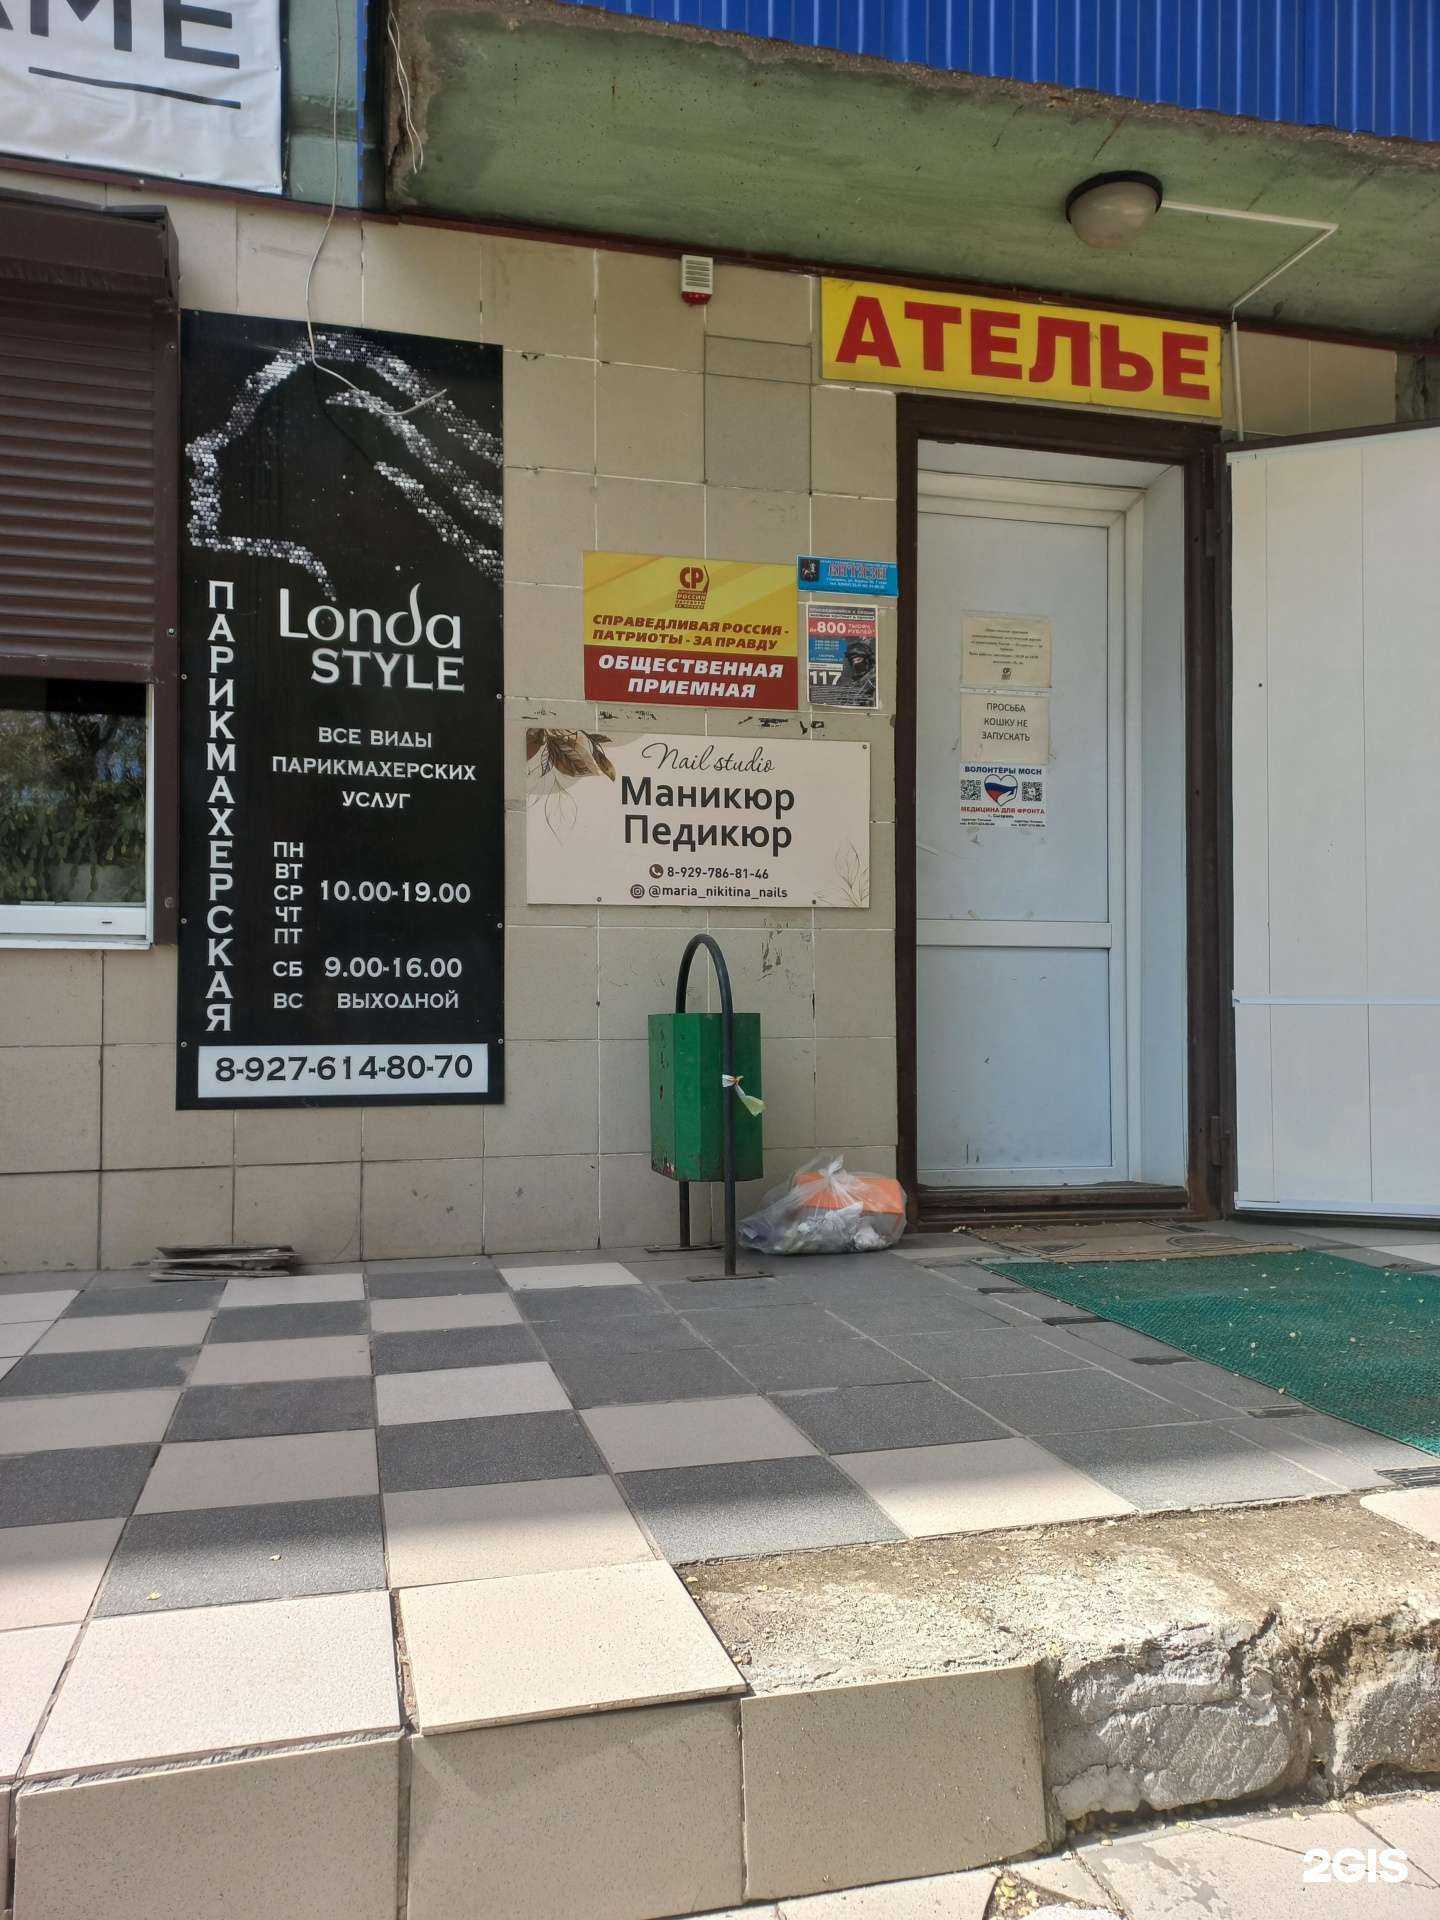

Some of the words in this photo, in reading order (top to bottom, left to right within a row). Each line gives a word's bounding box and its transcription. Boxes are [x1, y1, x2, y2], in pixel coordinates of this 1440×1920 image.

[836, 295, 1210, 400] АТЕЛЬЕ
[679, 566, 704, 589] СР
[279, 582, 461, 650] Londa
[592, 614, 720, 633] СПРАВЕДЛИВАЯ
[721, 623, 782, 636] РОССИЯ
[817, 621, 846, 635] 800
[592, 629, 683, 645] ПАТРИОТЫ
[692, 635, 712, 646] ЗА
[715, 636, 778, 651] ПРАВДУ
[311, 648, 465, 693] STYLE
[598, 654, 784, 679] ОБЩЕСТВЕННАЯ
[627, 678, 757, 699] ПРИЕМНАЯ
[809, 671, 842, 686] 117
[986, 702, 1026, 713] ПРОСЬБА
[984, 717, 1016, 727] КОШКУ
[1016, 719, 1028, 728] НЕ
[318, 726, 361, 745] ВСЕ
[370, 730, 432, 748] ВИДЫ
[981, 731, 1030, 742] ЗАПУСКАТЬ
[271, 756, 477, 781] ПАРИКМАХЕРСКИХ
[641, 742, 713, 771] Nail
[712, 746, 775, 774] studio
[205, 579, 237, 1032] ПАРИКМАХЕРСКАЯ
[341, 791, 411, 809] УСЛУГ
[621, 775, 796, 820] Маникюр
[960, 806, 1000, 815] МЕДИЦИНА
[1001, 807, 1016, 815] ДЛЯ
[1017, 808, 1045, 816] ФРОНТА
[624, 814, 793, 857] Педикюр
[273, 841, 304, 858] ПН
[275, 863, 303, 880] ВТ
[666, 866, 769, 881] 8-929-786-81-46
[273, 885, 304, 901] СР
[320, 880, 472, 904] 10.00-19.00
[648, 884, 789, 900] @maria_nikitina_nails
[275, 906, 302, 923] ЧТ
[273, 928, 303, 944] ПТ
[272, 961, 303, 978] СБ
[324, 956, 463, 979] 9.00-16.00
[273, 993, 304, 1009] ВС
[336, 989, 460, 1010] ВЫХОДНОЙ
[214, 1053, 474, 1083] 8-927-614-80-70
